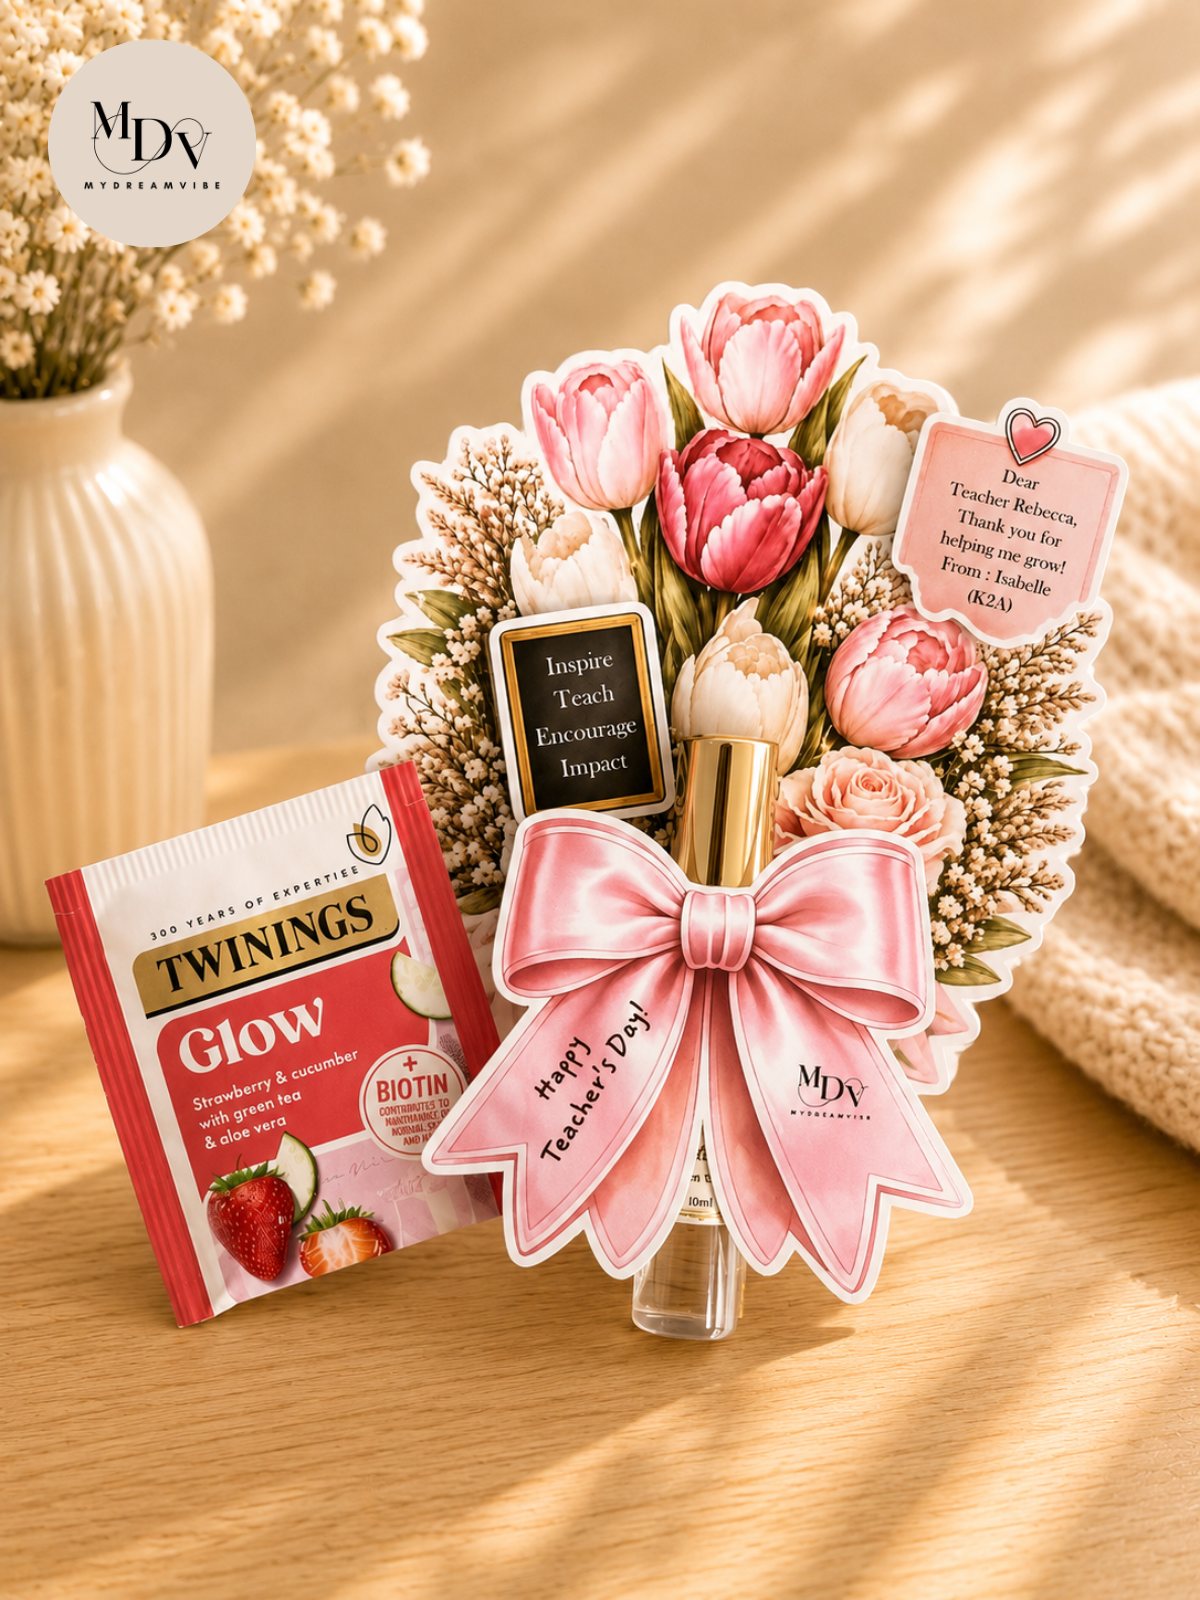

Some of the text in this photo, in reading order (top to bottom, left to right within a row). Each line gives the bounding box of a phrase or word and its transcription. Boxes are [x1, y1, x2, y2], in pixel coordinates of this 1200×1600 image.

[1002, 469, 1040, 490] Dear
[950, 481, 1077, 528] Teacher Rebecca,
[958, 508, 1062, 548] Thank you for
[940, 530, 1067, 574] helping me grow!
[941, 556, 981, 579] From
[994, 570, 1051, 597] Isabelle
[967, 589, 1013, 613] (K2A)
[546, 651, 614, 676] Inspire
[553, 684, 615, 709] Teach
[535, 720, 637, 747] Encourage
[561, 754, 628, 779] Impact
[150, 865, 359, 941] 300 YEARS OF EXPERTIEE
[156, 894, 373, 993] TWININGS
[179, 997, 323, 1074] Glow
[193, 1049, 359, 1111] Strawberry & cucumber
[376, 1073, 448, 1103] BIOTIN
[534, 1037, 591, 1100] Happy
[540, 1000, 651, 1161] Teacher's Day!
[797, 1064, 868, 1107] MDV
[199, 1089, 302, 1130] with green tea
[438, 1098, 450, 1108] TO
[205, 1116, 287, 1150] & aloe vera
